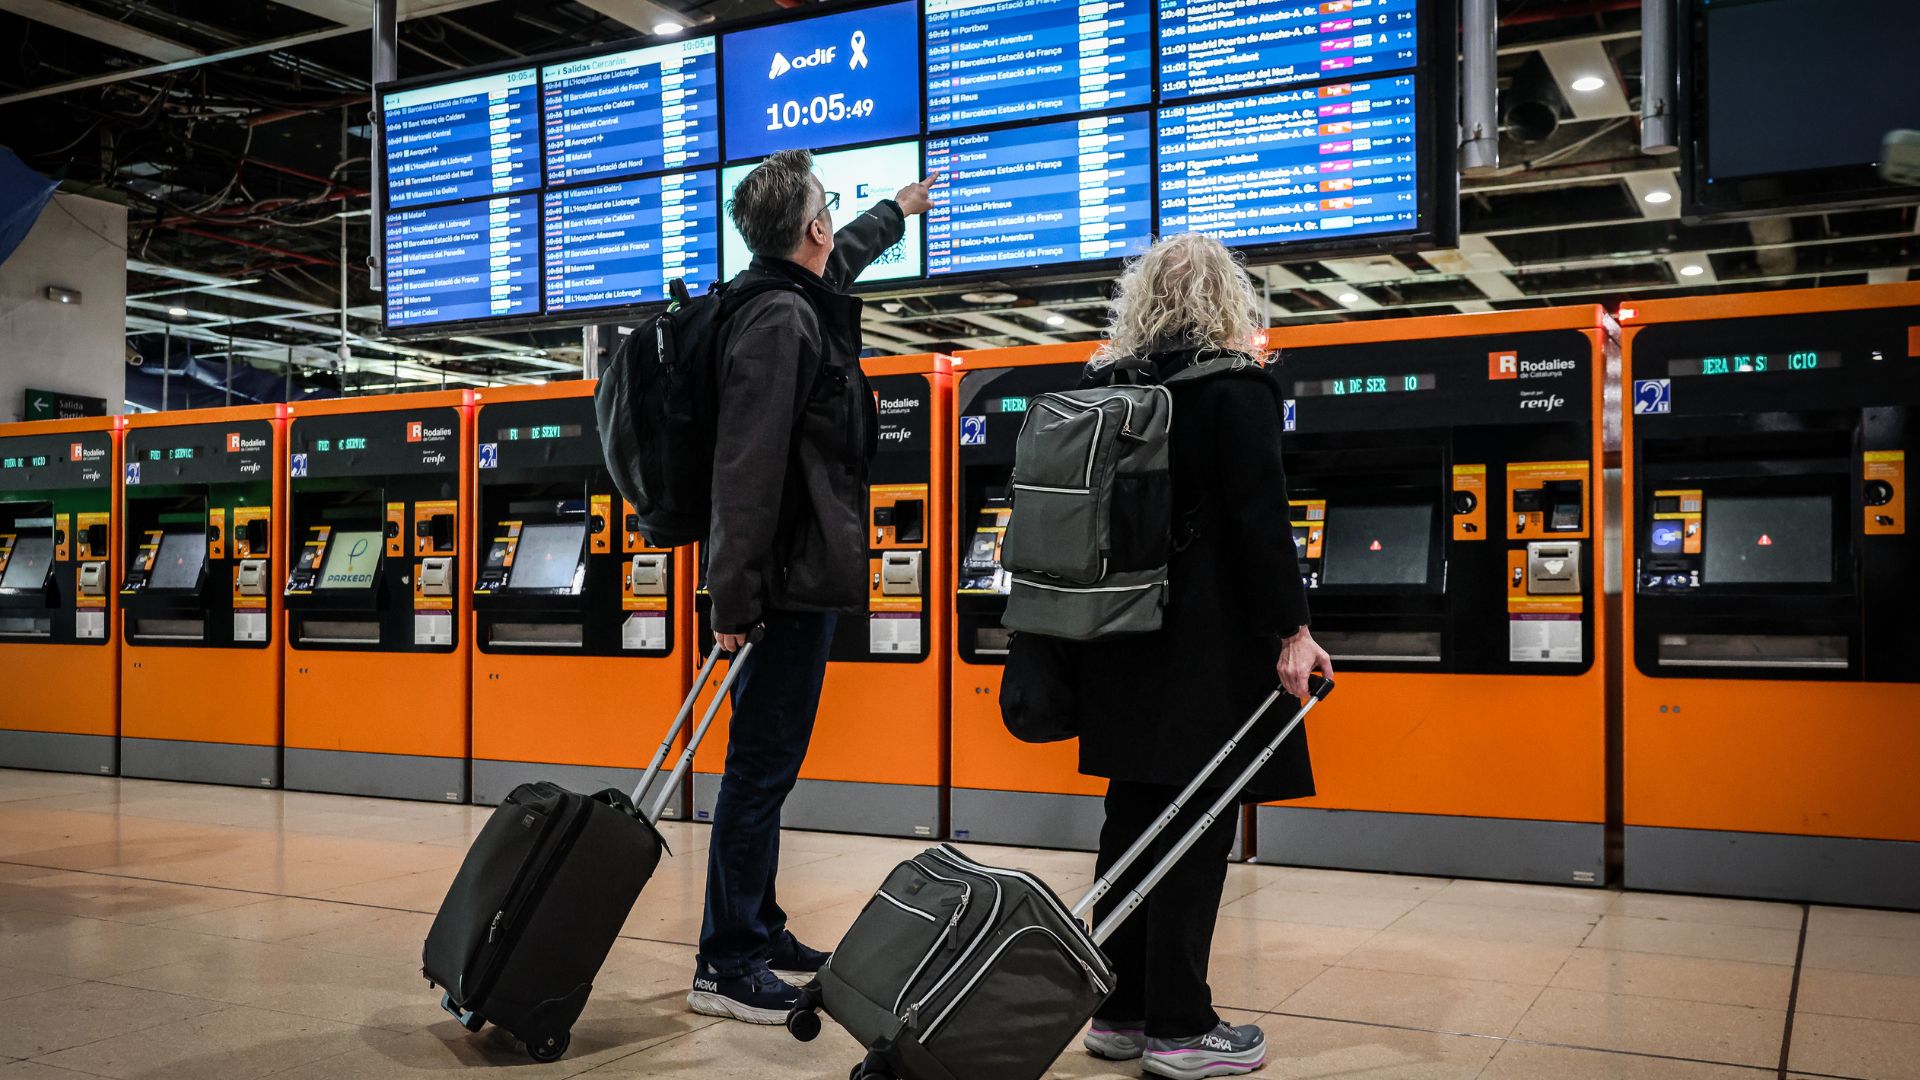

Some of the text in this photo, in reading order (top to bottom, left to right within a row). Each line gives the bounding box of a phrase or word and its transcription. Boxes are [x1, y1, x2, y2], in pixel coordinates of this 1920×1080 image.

[1161, 9, 1185, 19] 10:40
[1378, 15, 1387, 24] C
[960, 24, 988, 34] Portbou
[1188, 21, 1216, 33] Madrid
[1218, 17, 1245, 29] Puerta
[1247, 15, 1258, 25] de
[1162, 27, 1186, 37] 10:45
[960, 35, 1033, 51] Salou-Port Aventura
[1188, 39, 1216, 51] Madrid
[1218, 36, 1245, 47] Puerta
[1247, 34, 1258, 43] de
[1379, 34, 1387, 43] A
[1162, 44, 1186, 55] 11:00
[792, 46, 836, 68] adif
[960, 48, 1062, 68] Barcelona Estació de França
[563, 64, 590, 75] Salidas
[1162, 63, 1186, 73] 11:02
[1189, 75, 1223, 87] València
[1225, 70, 1256, 83] Estació
[1257, 69, 1270, 79] del
[1272, 66, 1293, 77] Nord
[570, 91, 597, 101] Barcelona
[599, 86, 619, 96] Estació
[629, 83, 648, 91] França
[1162, 81, 1187, 91] 11:05
[961, 94, 978, 102] Reus
[766, 93, 873, 130] 10:05:49
[1187, 103, 1215, 115] Madrid
[1217, 100, 1244, 111] Puerta
[1245, 98, 1257, 107] de
[1160, 108, 1184, 118] 11:50
[1160, 126, 1185, 136] 12:00
[572, 134, 596, 145] Aeroport
[959, 135, 988, 145] Cerbère
[1187, 139, 1216, 151] Madrid
[1217, 136, 1244, 147] Puerta
[1246, 135, 1257, 144] de
[410, 145, 432, 156] Aeroport
[572, 150, 592, 160] Mataró
[959, 153, 986, 162] Tortosa
[573, 158, 642, 175] Terrassa Estació del Nord
[960, 169, 996, 179] Barcelona
[997, 164, 1024, 175] Estació
[1036, 162, 1062, 170] França
[960, 187, 990, 197] Figueres
[960, 201, 1012, 213] Lleida Pirineus
[961, 233, 1034, 246] Salou-Port Aventura
[1500, 355, 1575, 373] R Rodalies
[1756, 356, 1767, 372] S
[1350, 379, 1362, 392] DE
[1366, 378, 1386, 392] SER
[880, 399, 919, 408] Rodalies
[1002, 398, 1026, 412] FUERA
[1520, 394, 1564, 412] renfe
[60, 411, 87, 419] Sortid
[412, 425, 452, 438] R Rodalies
[532, 428, 540, 439] DE
[880, 428, 911, 442] renfe
[232, 436, 266, 448] R Rodalies
[423, 453, 445, 465] renfe
[240, 462, 260, 474] renfe
[82, 470, 100, 482] renfe
[327, 574, 372, 582] PARKEON
[695, 978, 717, 992] HOKA
[1201, 1034, 1232, 1051] HOKA
